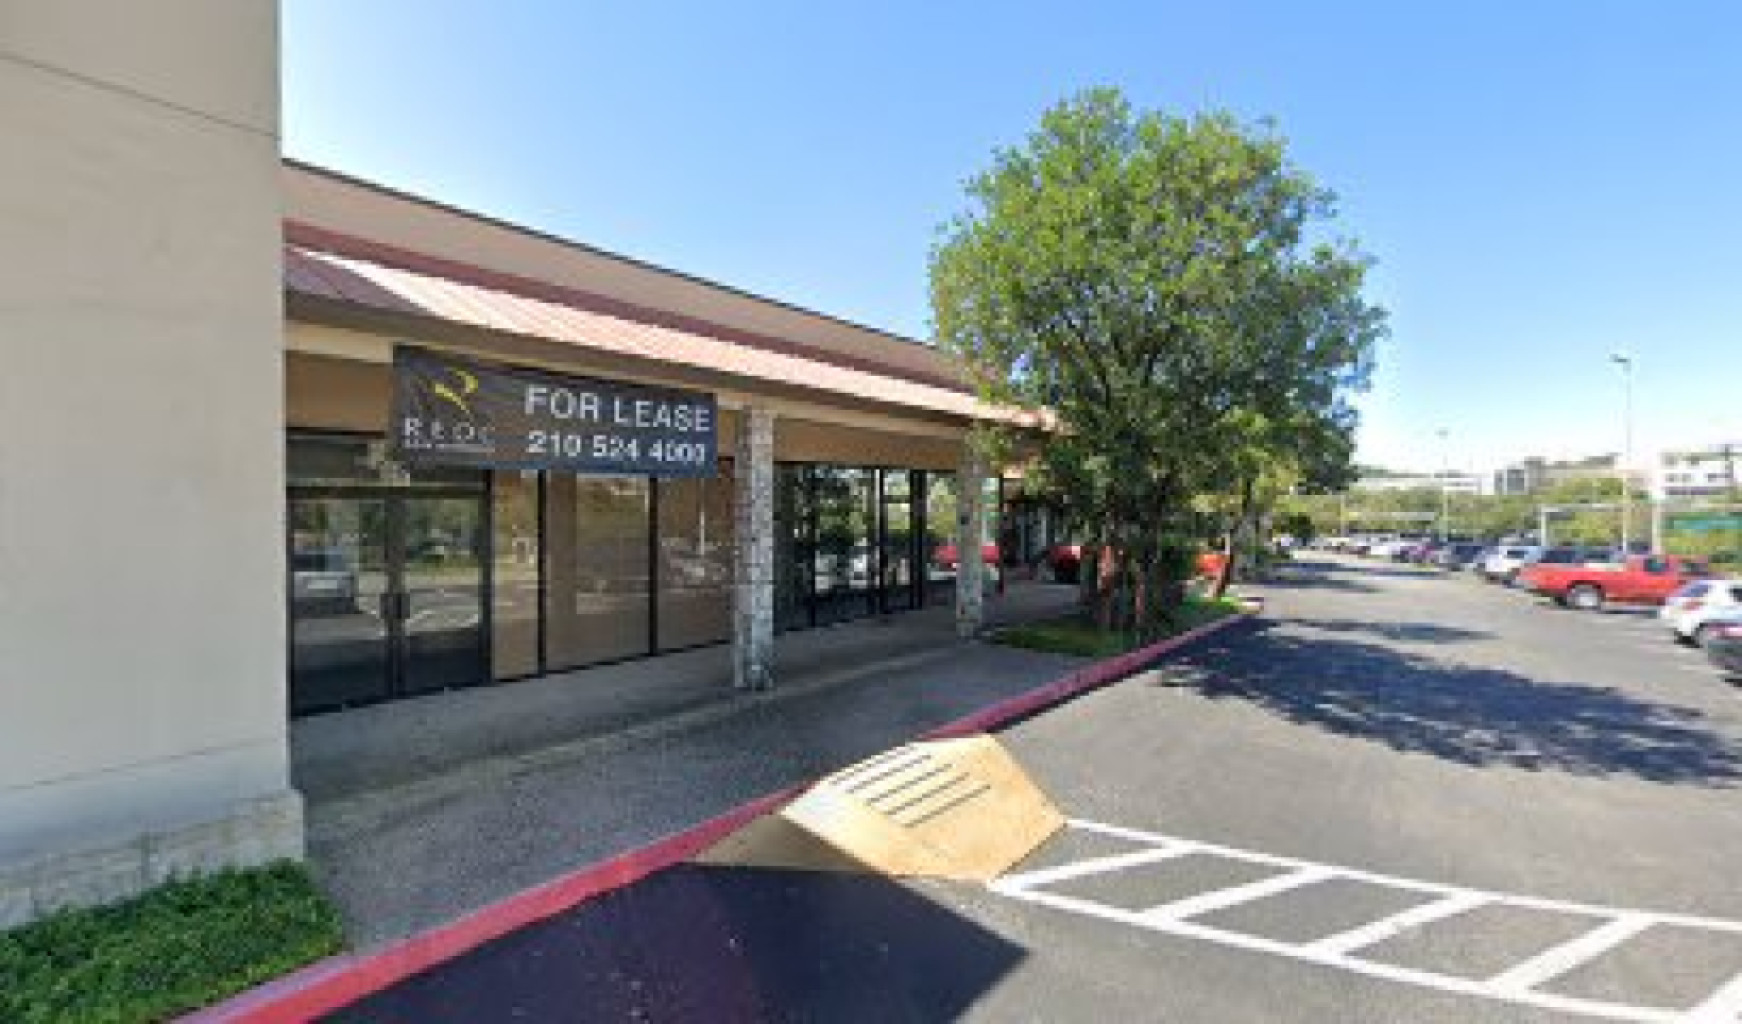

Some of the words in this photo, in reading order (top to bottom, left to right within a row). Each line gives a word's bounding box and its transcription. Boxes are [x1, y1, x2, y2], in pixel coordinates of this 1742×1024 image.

[524, 385, 600, 422] FOR
[614, 396, 710, 432] LEASE
[526, 430, 581, 457] 210
[592, 435, 637, 461] 524
